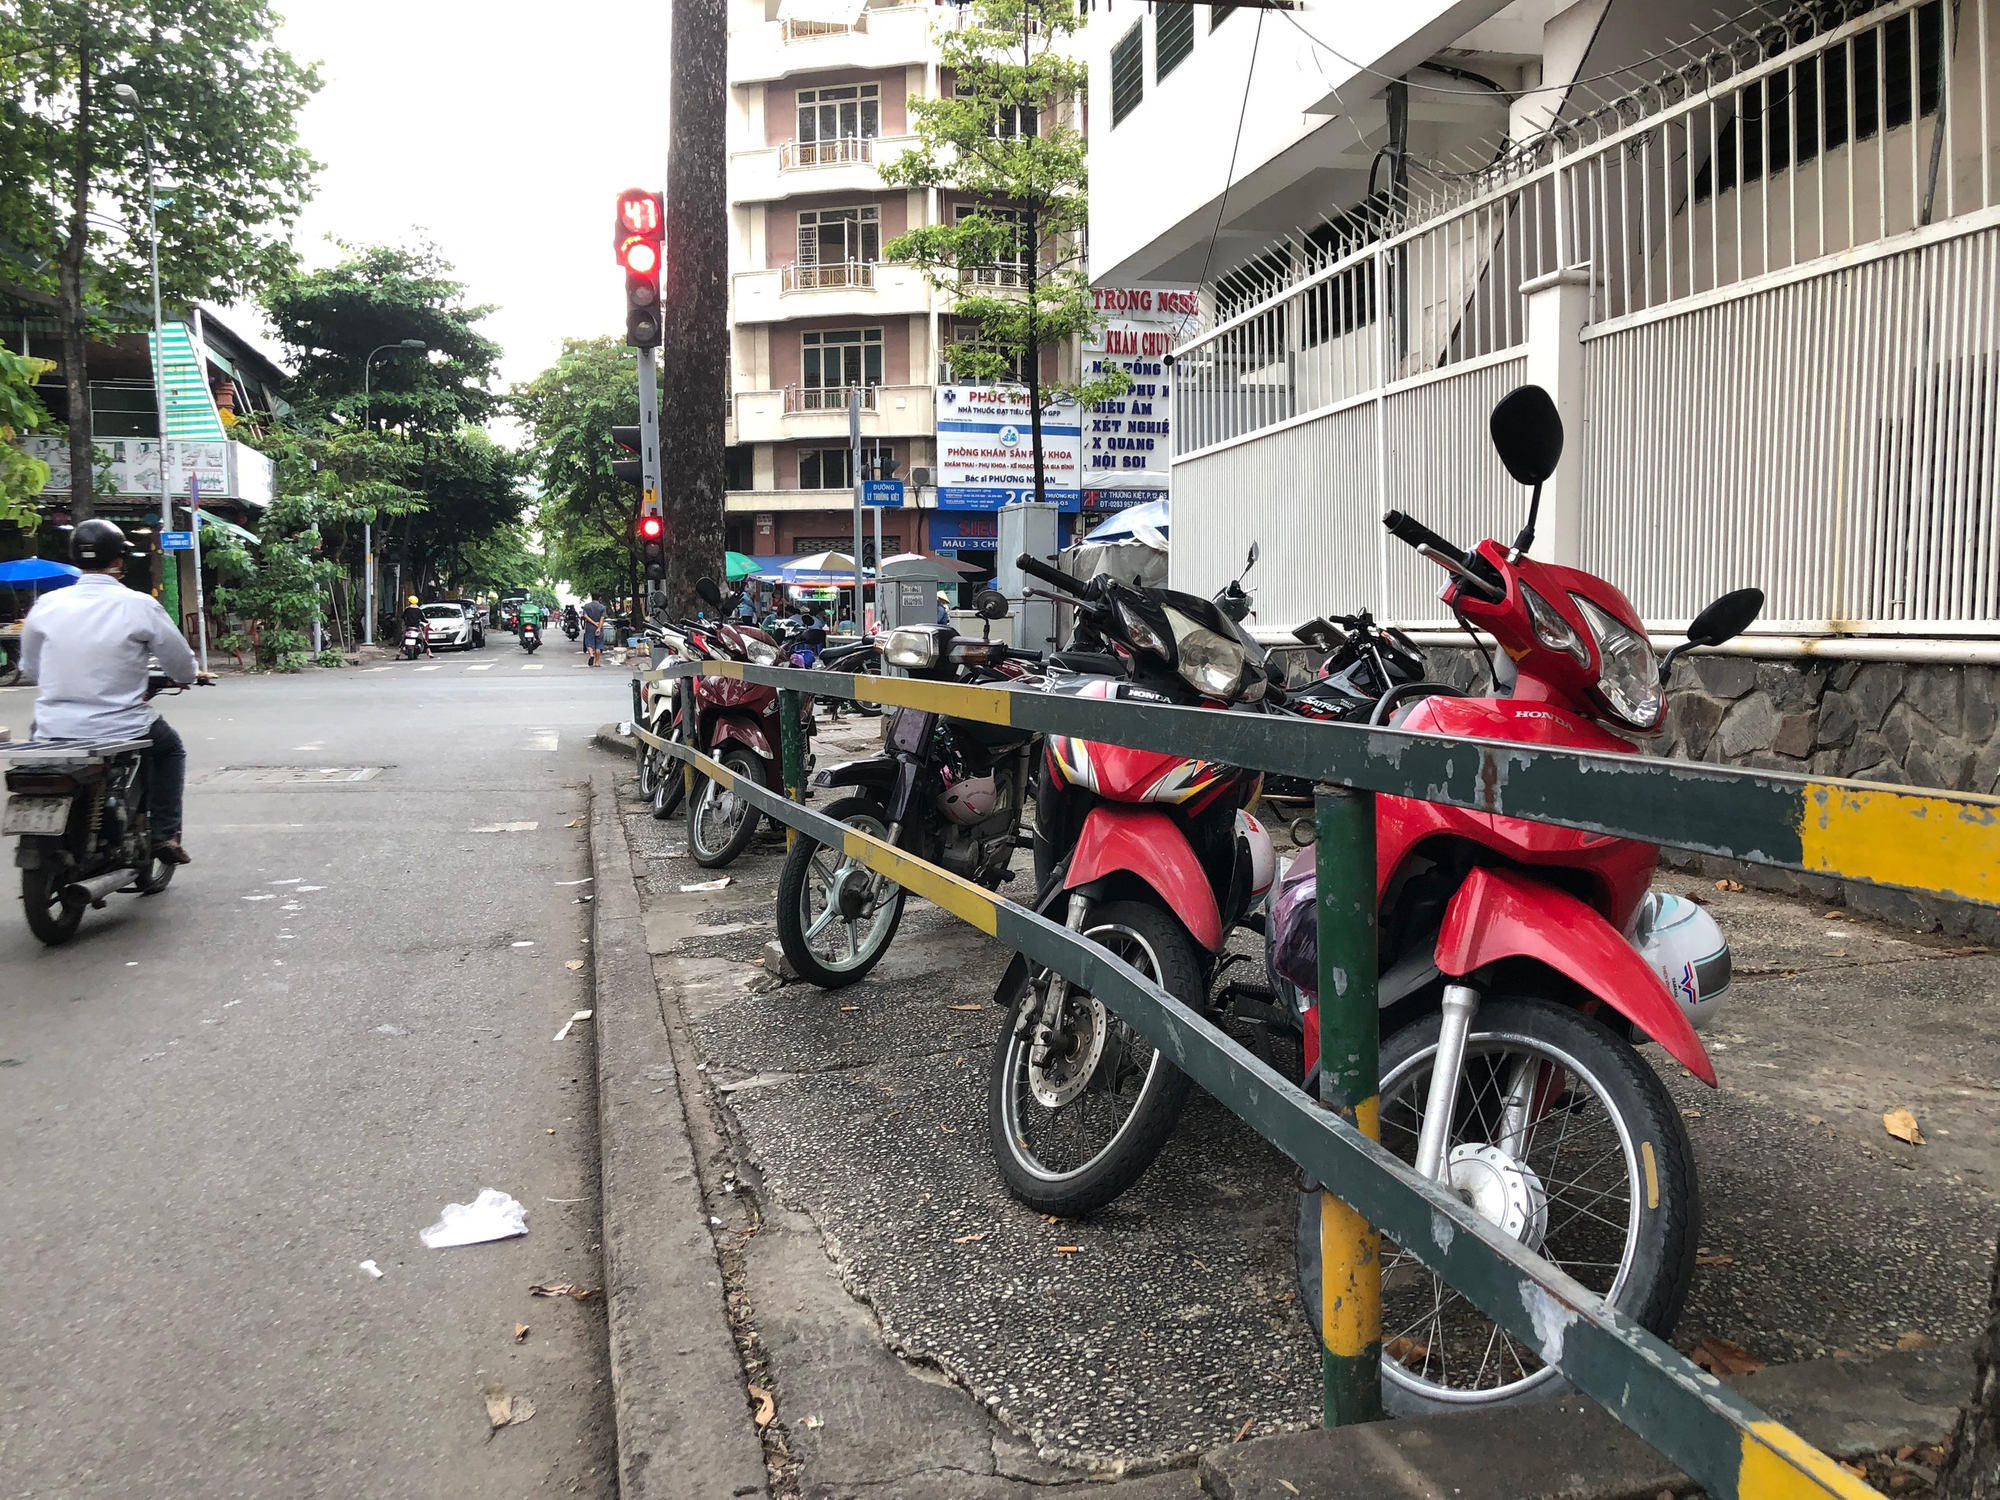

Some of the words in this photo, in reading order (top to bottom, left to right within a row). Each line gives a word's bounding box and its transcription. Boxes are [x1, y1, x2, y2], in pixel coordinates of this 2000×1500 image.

[1094, 289, 1153, 315] TRỌNG
[1106, 323, 1138, 356] KHÁM
[957, 405, 972, 414] NHÀ
[973, 405, 996, 415] THUỐC
[1131, 399, 1153, 415] ÂM
[1092, 415, 1121, 432] XÉT
[1128, 418, 1169, 438] NGHIỆ
[1092, 437, 1102, 450] X
[1107, 437, 1155, 451] QUANG
[947, 446, 979, 457] PHÒNG
[980, 447, 1007, 458] KHÁM
[1049, 451, 1072, 460] KHOA
[1092, 451, 1117, 470] NỘI
[1122, 455, 1146, 469] SOI
[873, 483, 895, 491] ĐƯỜNG
[973, 540, 979, 548] 3
[1128, 689, 1172, 704] HONDA
[1300, 696, 1342, 713] SATRIA
[1514, 710, 1575, 733] HONDA
